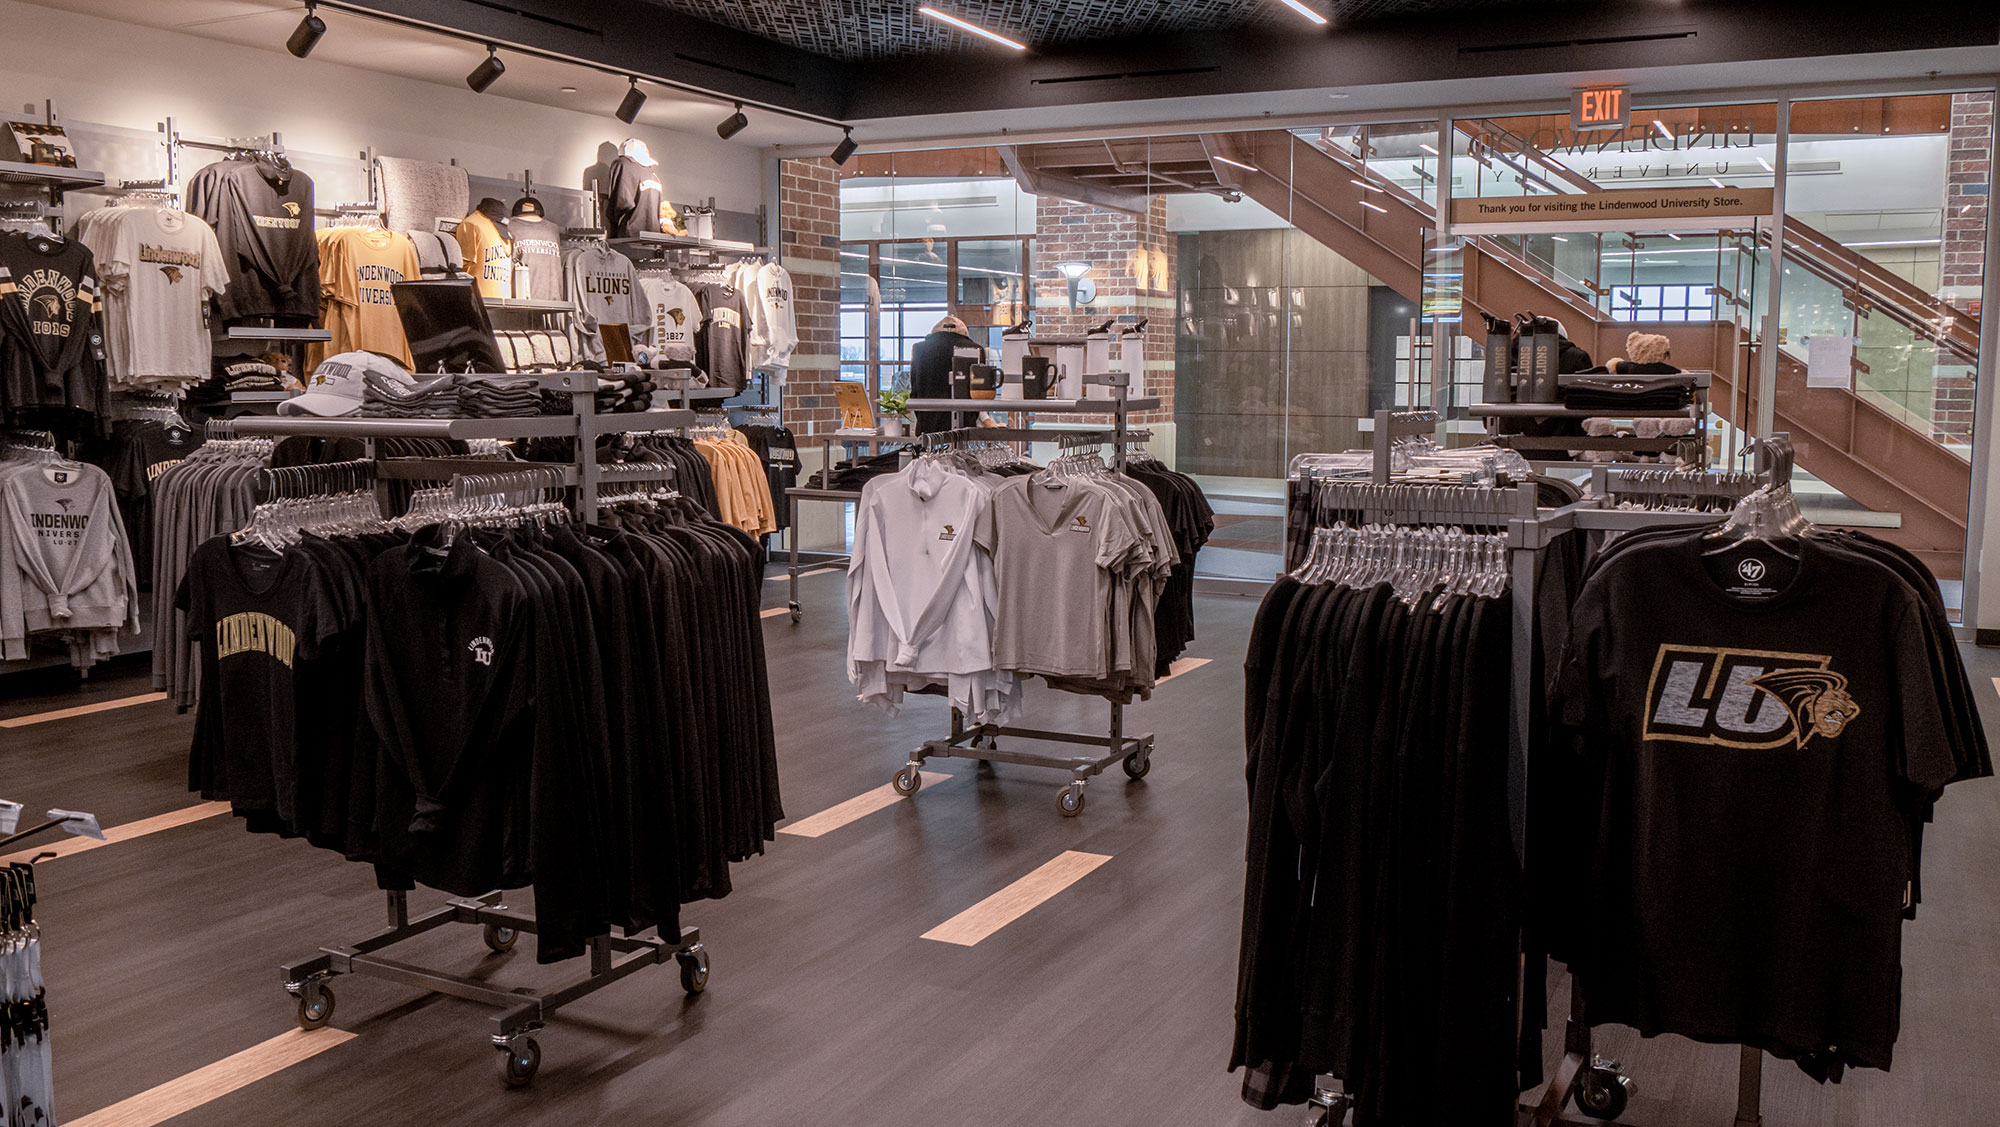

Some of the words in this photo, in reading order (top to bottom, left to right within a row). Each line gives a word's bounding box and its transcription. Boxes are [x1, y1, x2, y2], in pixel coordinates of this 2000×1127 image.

[1581, 90, 1622, 122] EXIT
[1478, 203, 1506, 213] Thank
[1508, 205, 1525, 214] you
[1528, 203, 1541, 212] for
[1544, 202, 1578, 213] visiting
[1580, 201, 1595, 211] the
[1599, 199, 1658, 210] Lindenwood
[1661, 197, 1710, 209] University
[1713, 196, 1743, 207] Store.
[585, 276, 630, 295] LIONS
[666, 332, 685, 340] 1827
[1495, 346, 1506, 375] LIONS
[1520, 346, 1531, 376] LIONS
[1536, 345, 1547, 375] LIONS
[1652, 660, 1790, 734] LU
